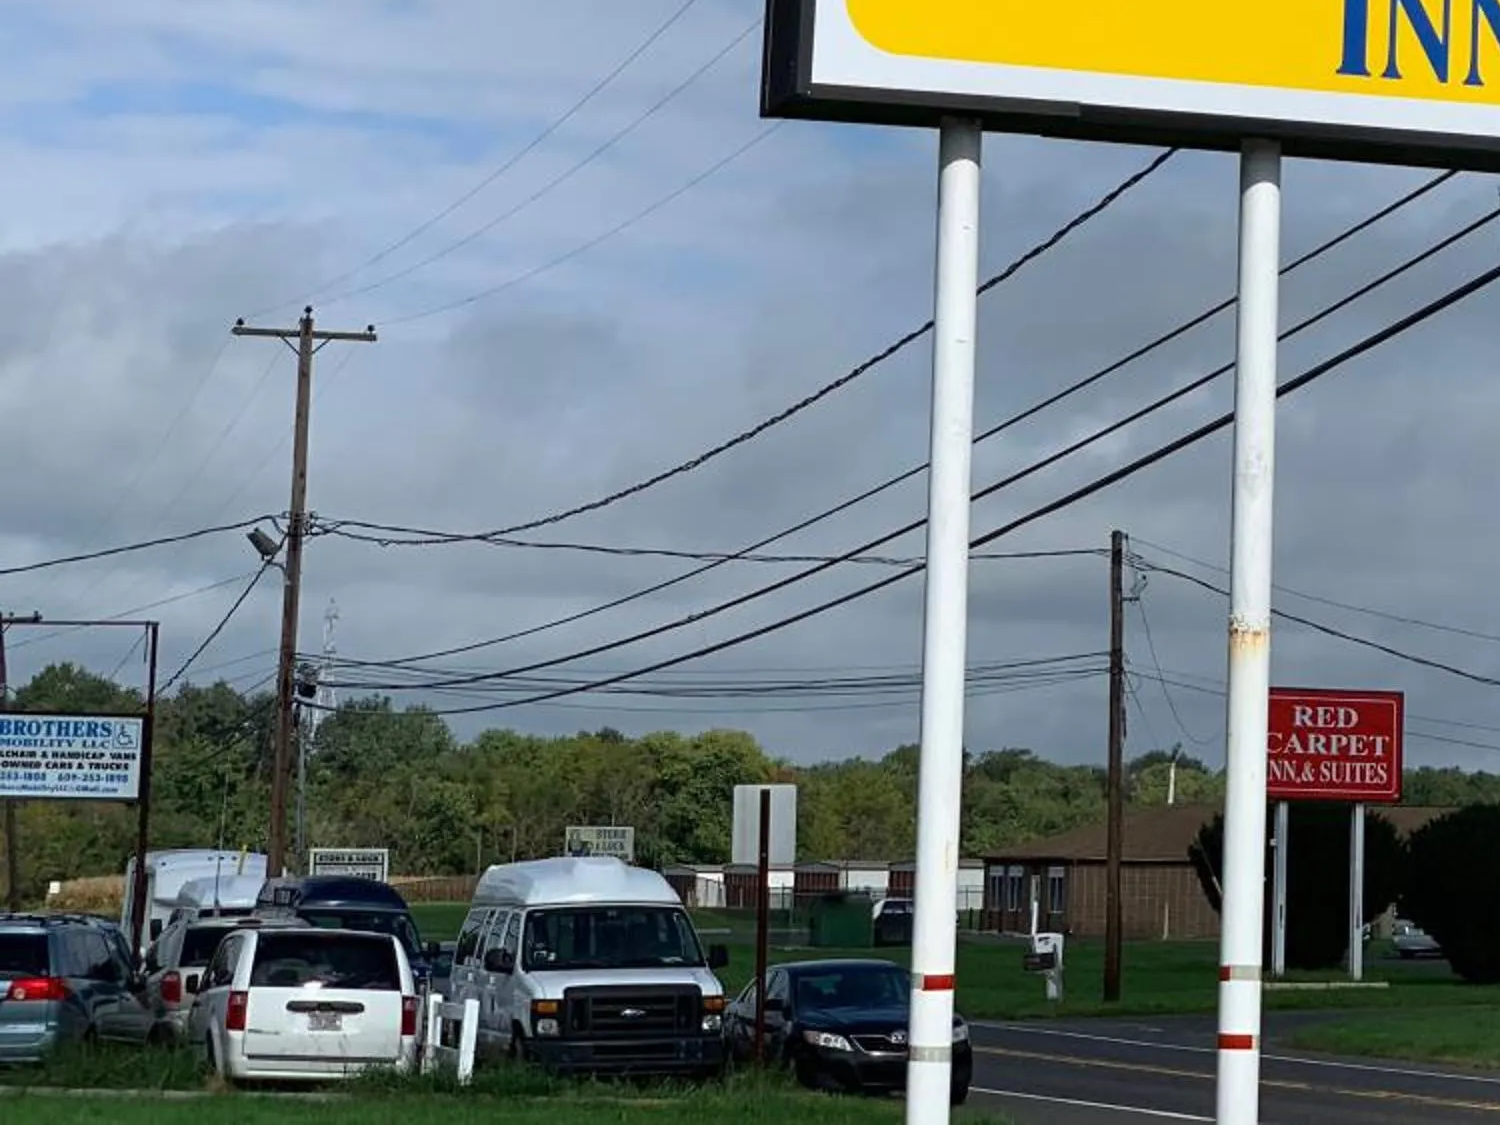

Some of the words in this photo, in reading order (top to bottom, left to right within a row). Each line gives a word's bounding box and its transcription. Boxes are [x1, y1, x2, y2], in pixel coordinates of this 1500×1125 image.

[1294, 705, 1359, 728] RED
[0, 719, 112, 737] BROTHERS
[82, 740, 110, 749] LLC
[1266, 732, 1389, 757] CARPET
[52, 751, 105, 760] HANDICAP
[45, 762, 73, 770] CARS
[88, 762, 129, 771] TRUCKS
[1319, 761, 1387, 784] SUITES
